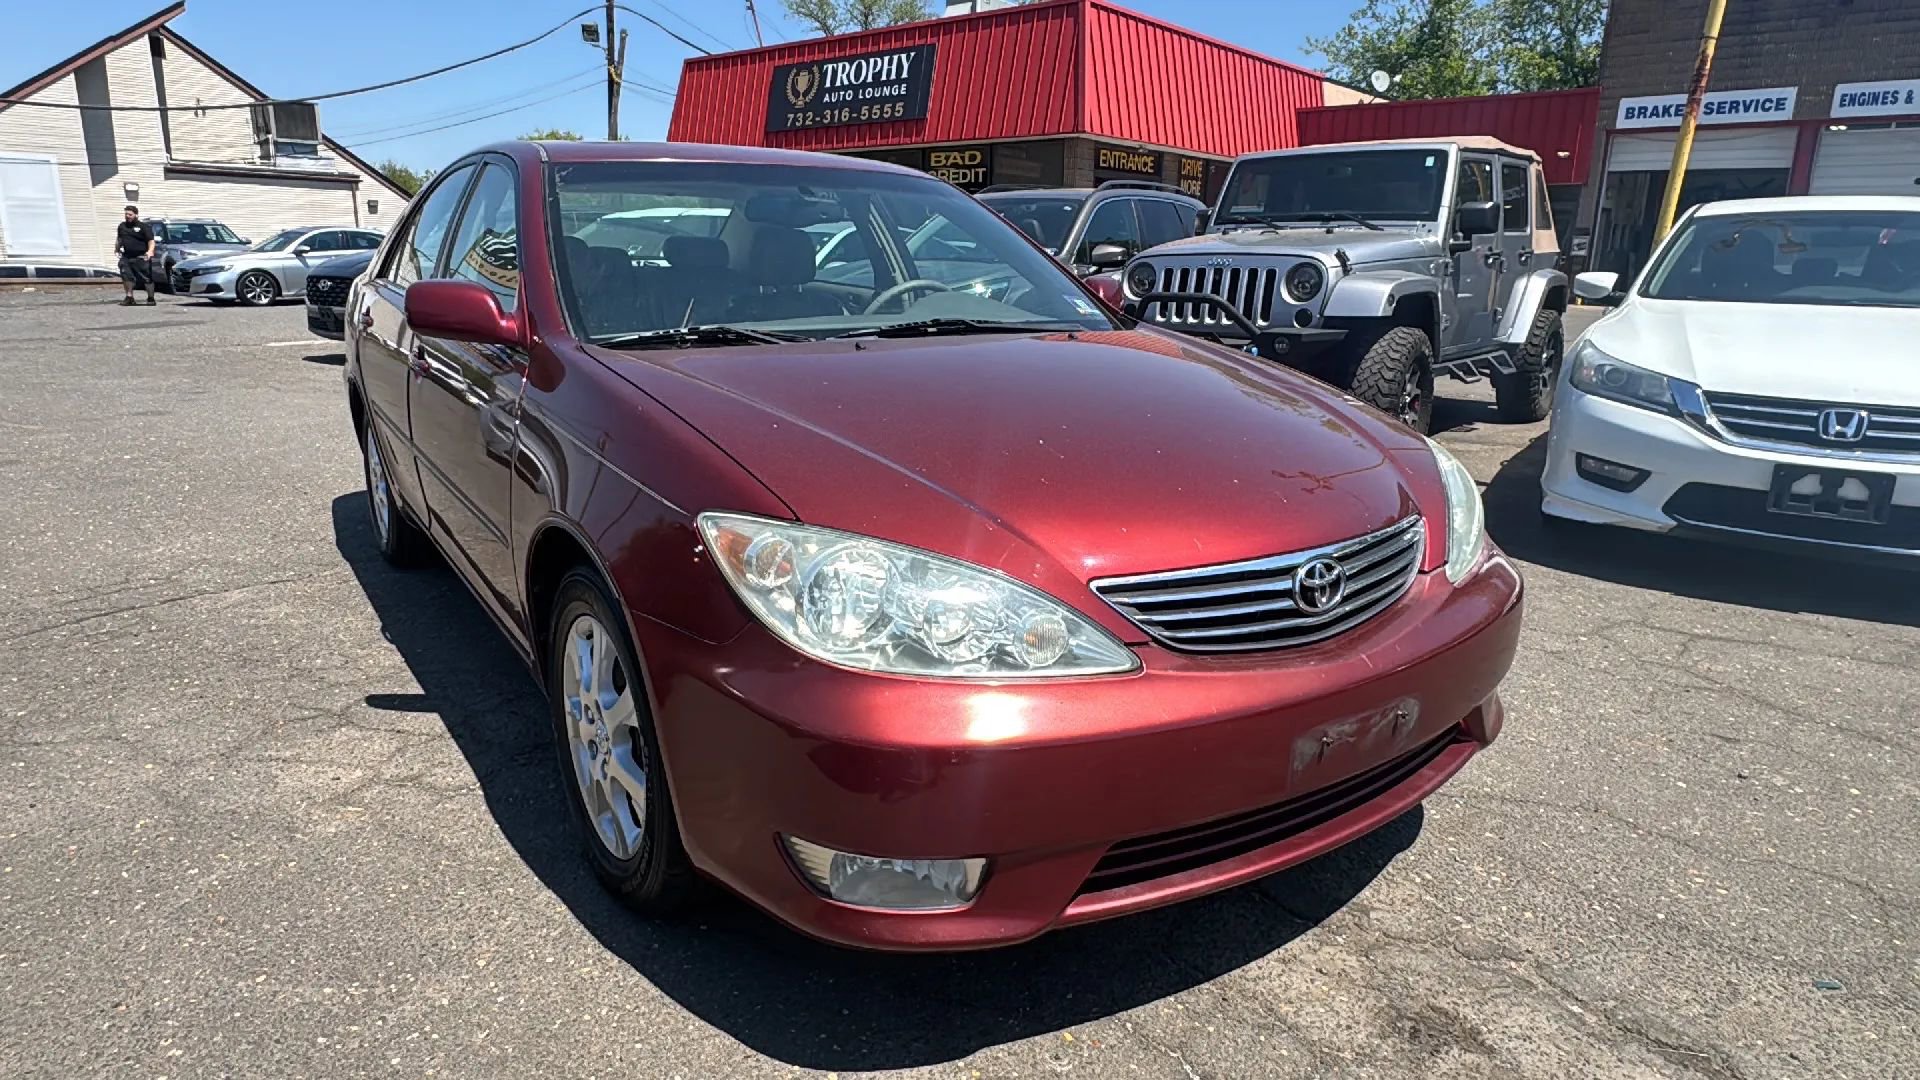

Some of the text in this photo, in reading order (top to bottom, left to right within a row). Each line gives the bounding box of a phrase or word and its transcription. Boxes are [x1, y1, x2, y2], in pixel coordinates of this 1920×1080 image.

[822, 51, 916, 88] TROPHY
[823, 83, 907, 103] AUTO LOUNGE
[1839, 90, 1914, 108] ENGINES &
[786, 102, 904, 127] 732-316-5555
[1624, 97, 1788, 120] BRAKE SERVICE
[930, 150, 982, 167] BAD
[1100, 149, 1154, 173] ENTRANCE
[1181, 158, 1202, 178] DRIVE
